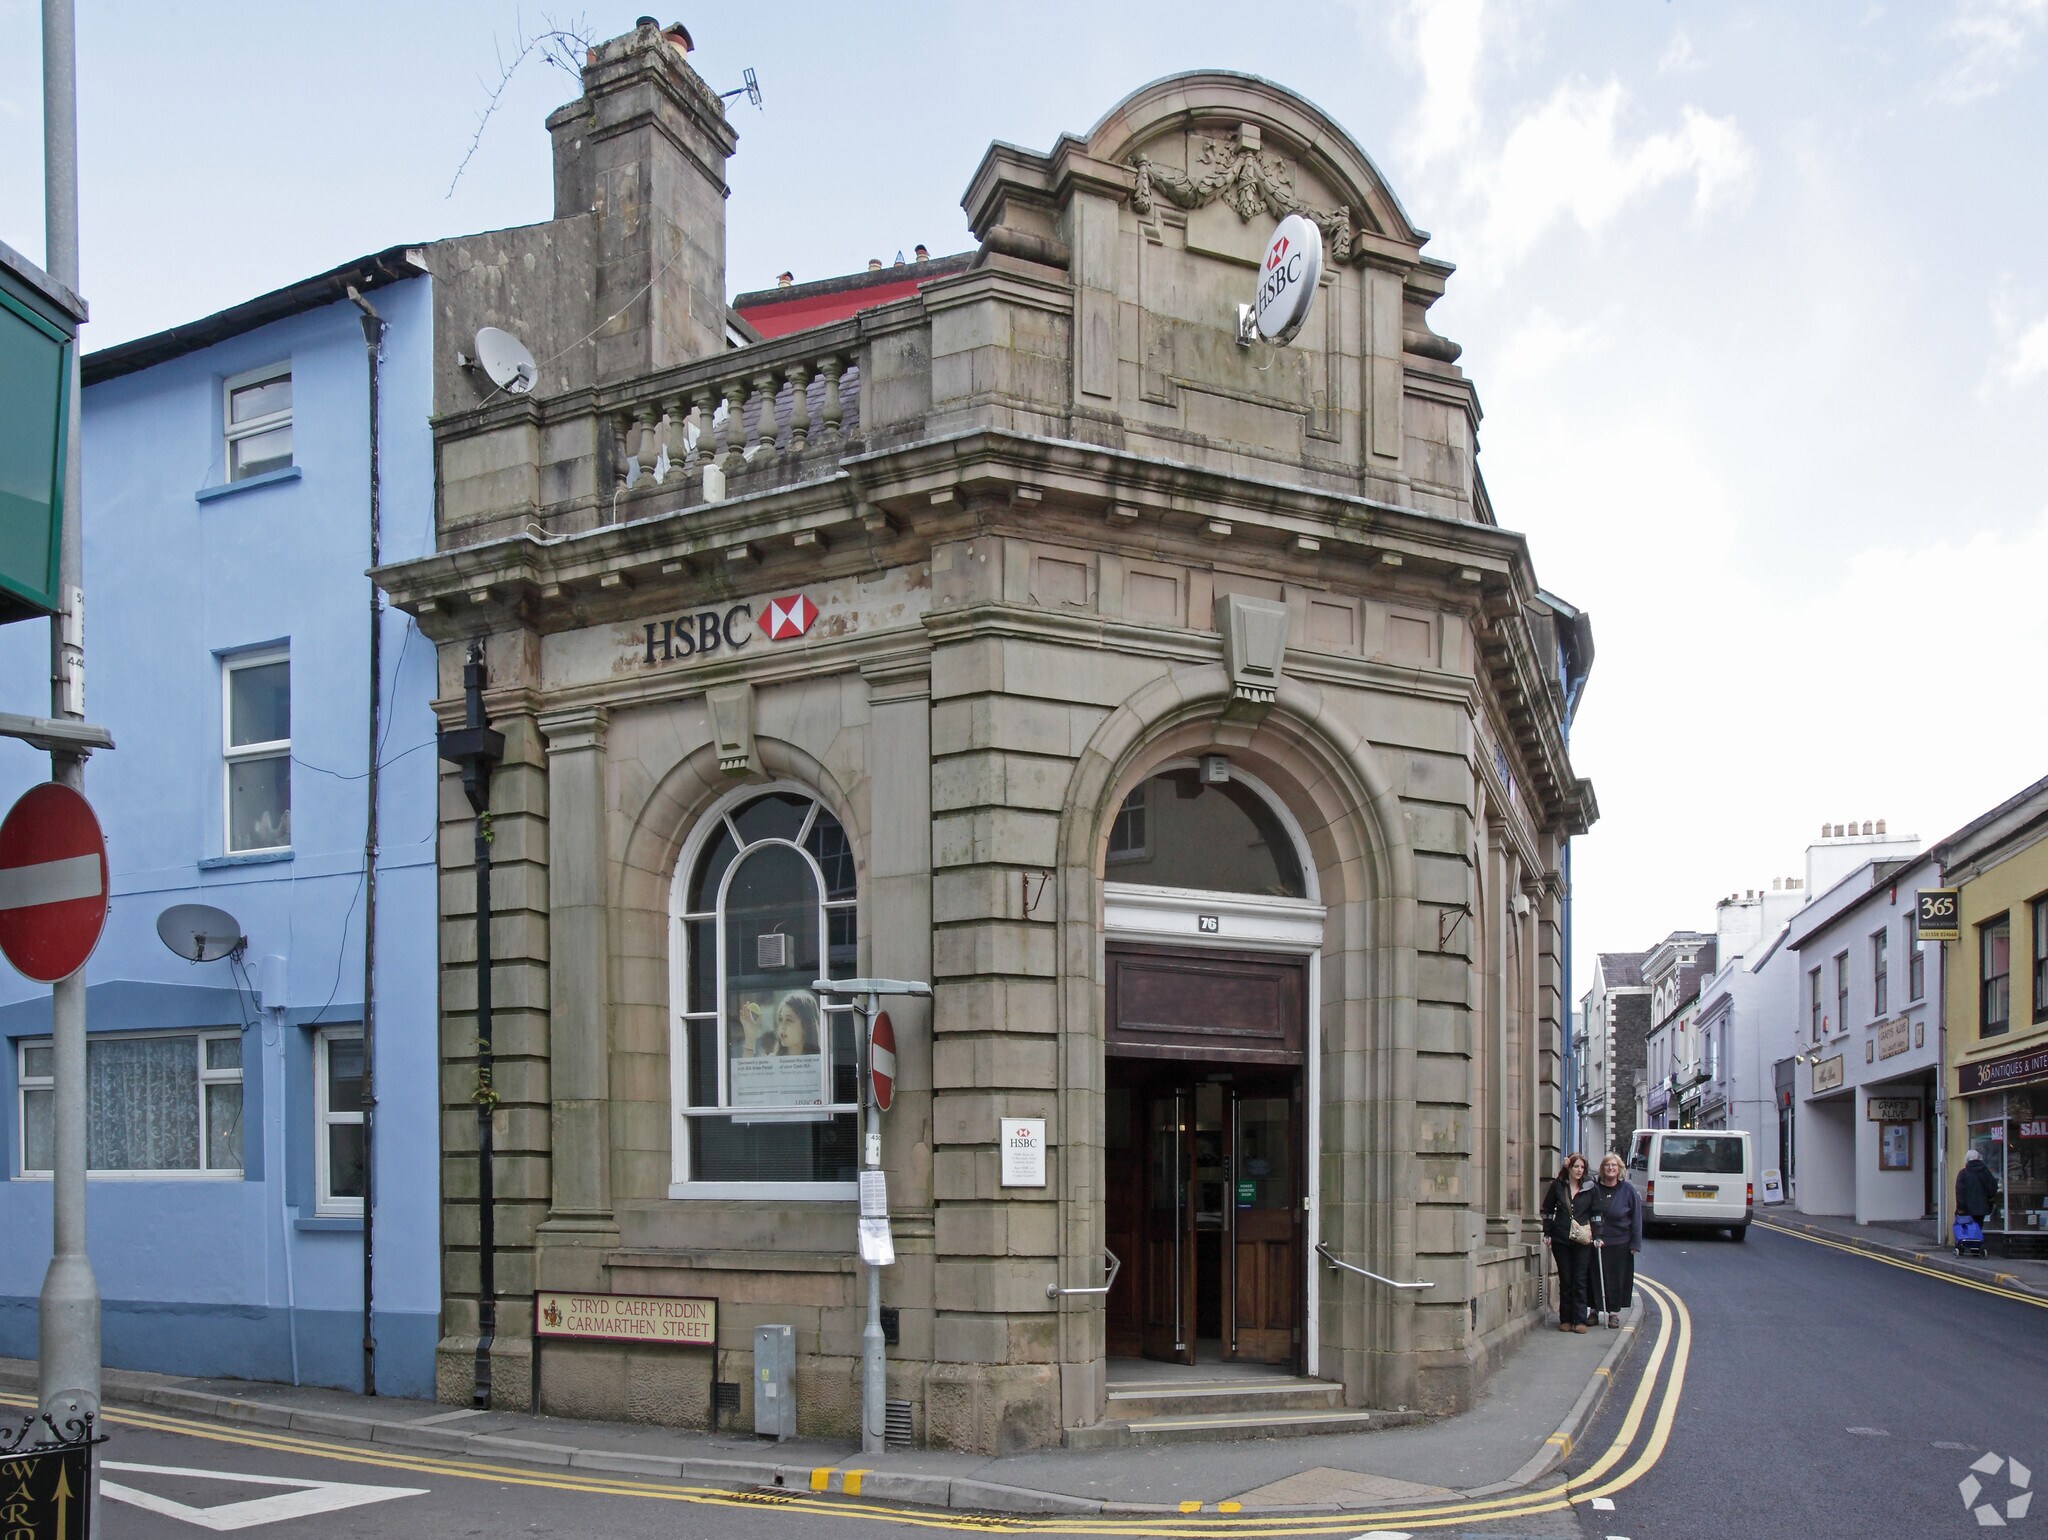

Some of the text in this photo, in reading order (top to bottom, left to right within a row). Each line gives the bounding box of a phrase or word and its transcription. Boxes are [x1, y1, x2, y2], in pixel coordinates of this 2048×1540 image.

[1258, 252, 1302, 317] HSBC
[643, 603, 752, 663] HSBC
[1921, 897, 1954, 919] 365
[1201, 917, 1217, 930] 76
[1977, 1064, 1991, 1086] 365
[1991, 1061, 2023, 1078] ANTIQUES
[2025, 1061, 2030, 1072] &
[1879, 1101, 1910, 1110] CRAFTS
[1882, 1110, 1906, 1118] ALIVE
[1010, 1138, 1037, 1148] HSBC
[571, 1298, 706, 1318] STRYD CAERFYRDDIN
[567, 1316, 710, 1337] CARMARTHEN STREET
